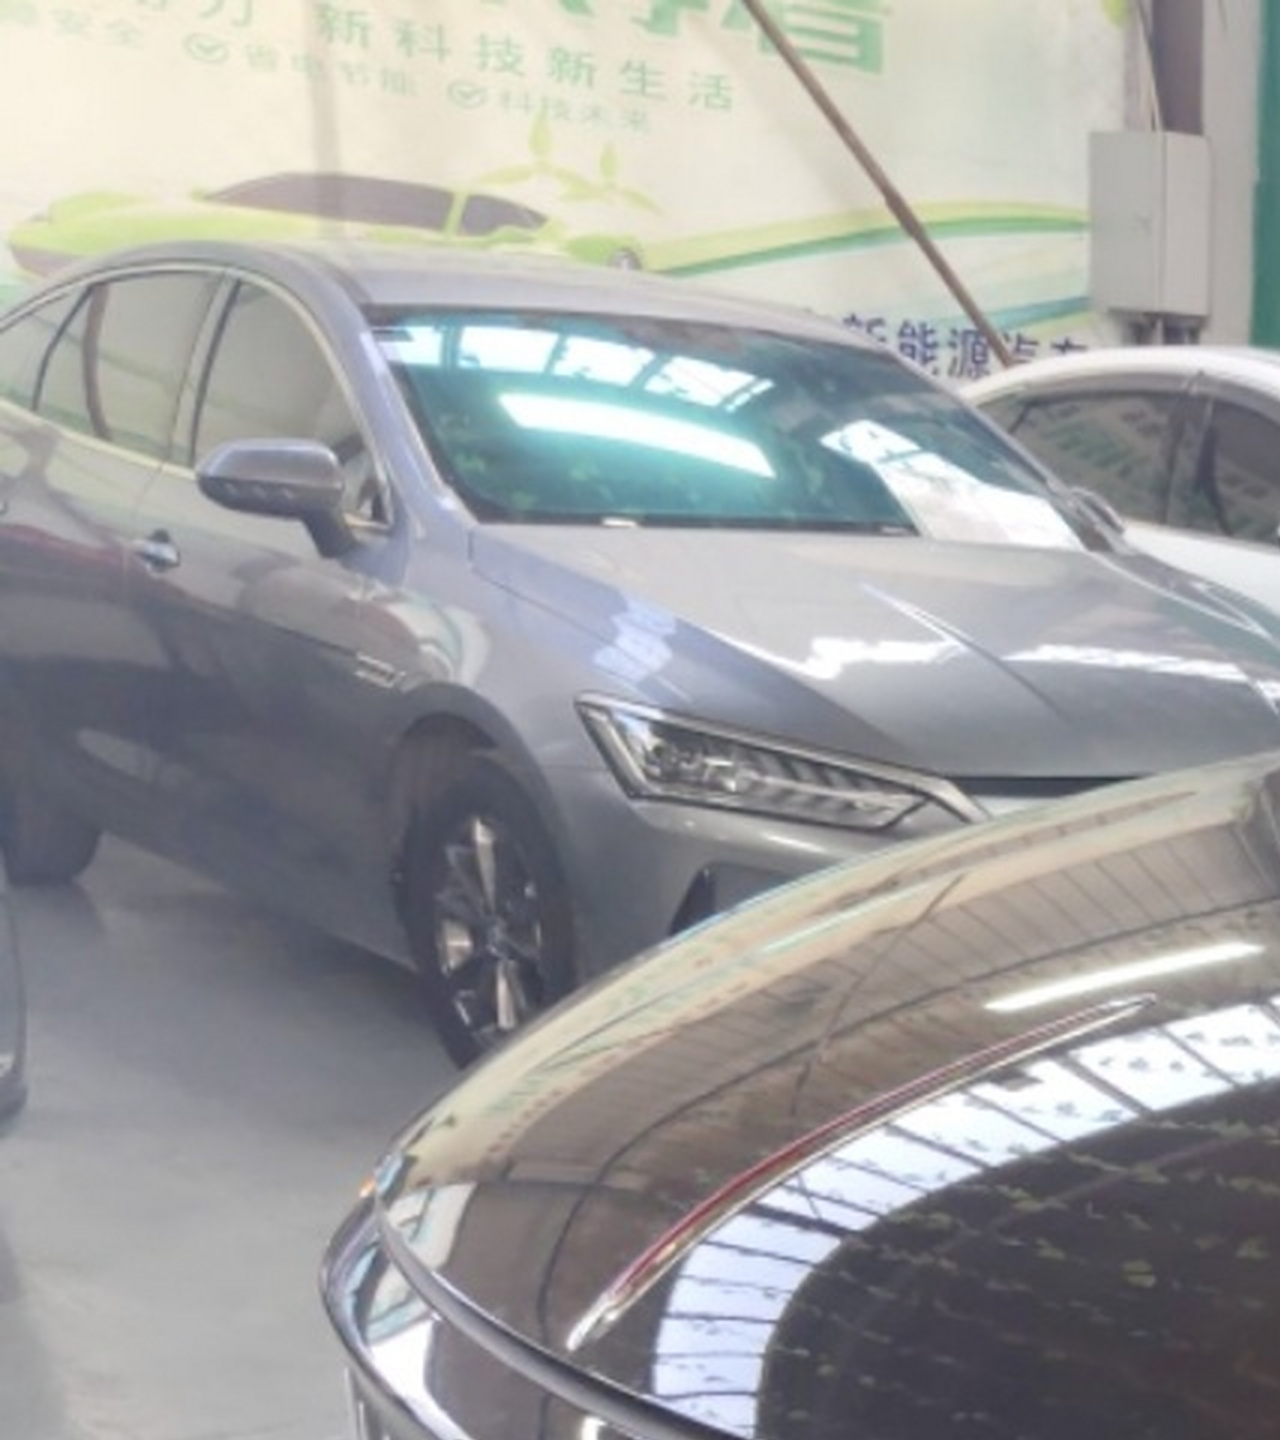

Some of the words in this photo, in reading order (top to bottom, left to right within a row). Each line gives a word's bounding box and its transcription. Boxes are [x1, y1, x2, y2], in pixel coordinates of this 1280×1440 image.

[316, 3, 734, 111] 新科技新生活
[843, 312, 1089, 379] 能源汽
